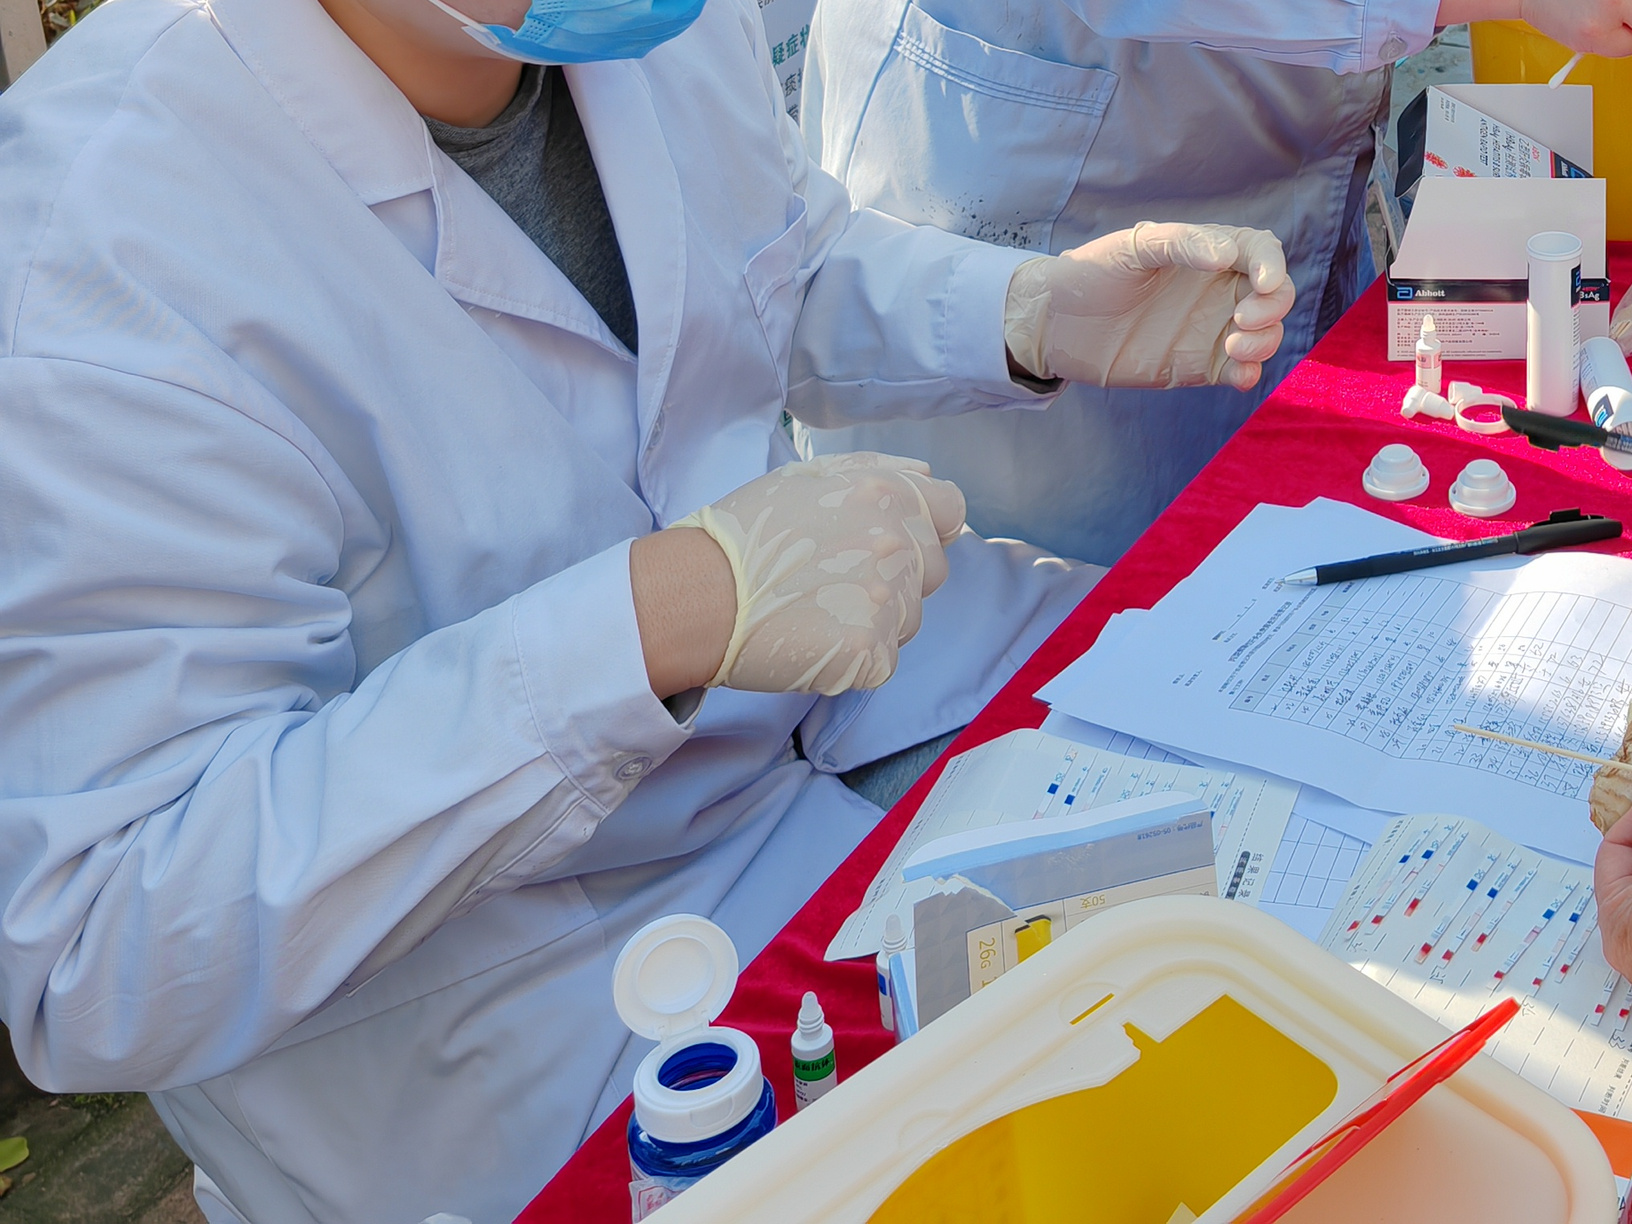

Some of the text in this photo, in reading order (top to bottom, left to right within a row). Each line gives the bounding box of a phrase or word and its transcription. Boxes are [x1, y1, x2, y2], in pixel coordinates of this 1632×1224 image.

[1415, 289, 1446, 298] Abbott
[1579, 291, 1600, 301] BsAg
[1080, 894, 1106, 909] 50支
[978, 936, 998, 970] 26G
